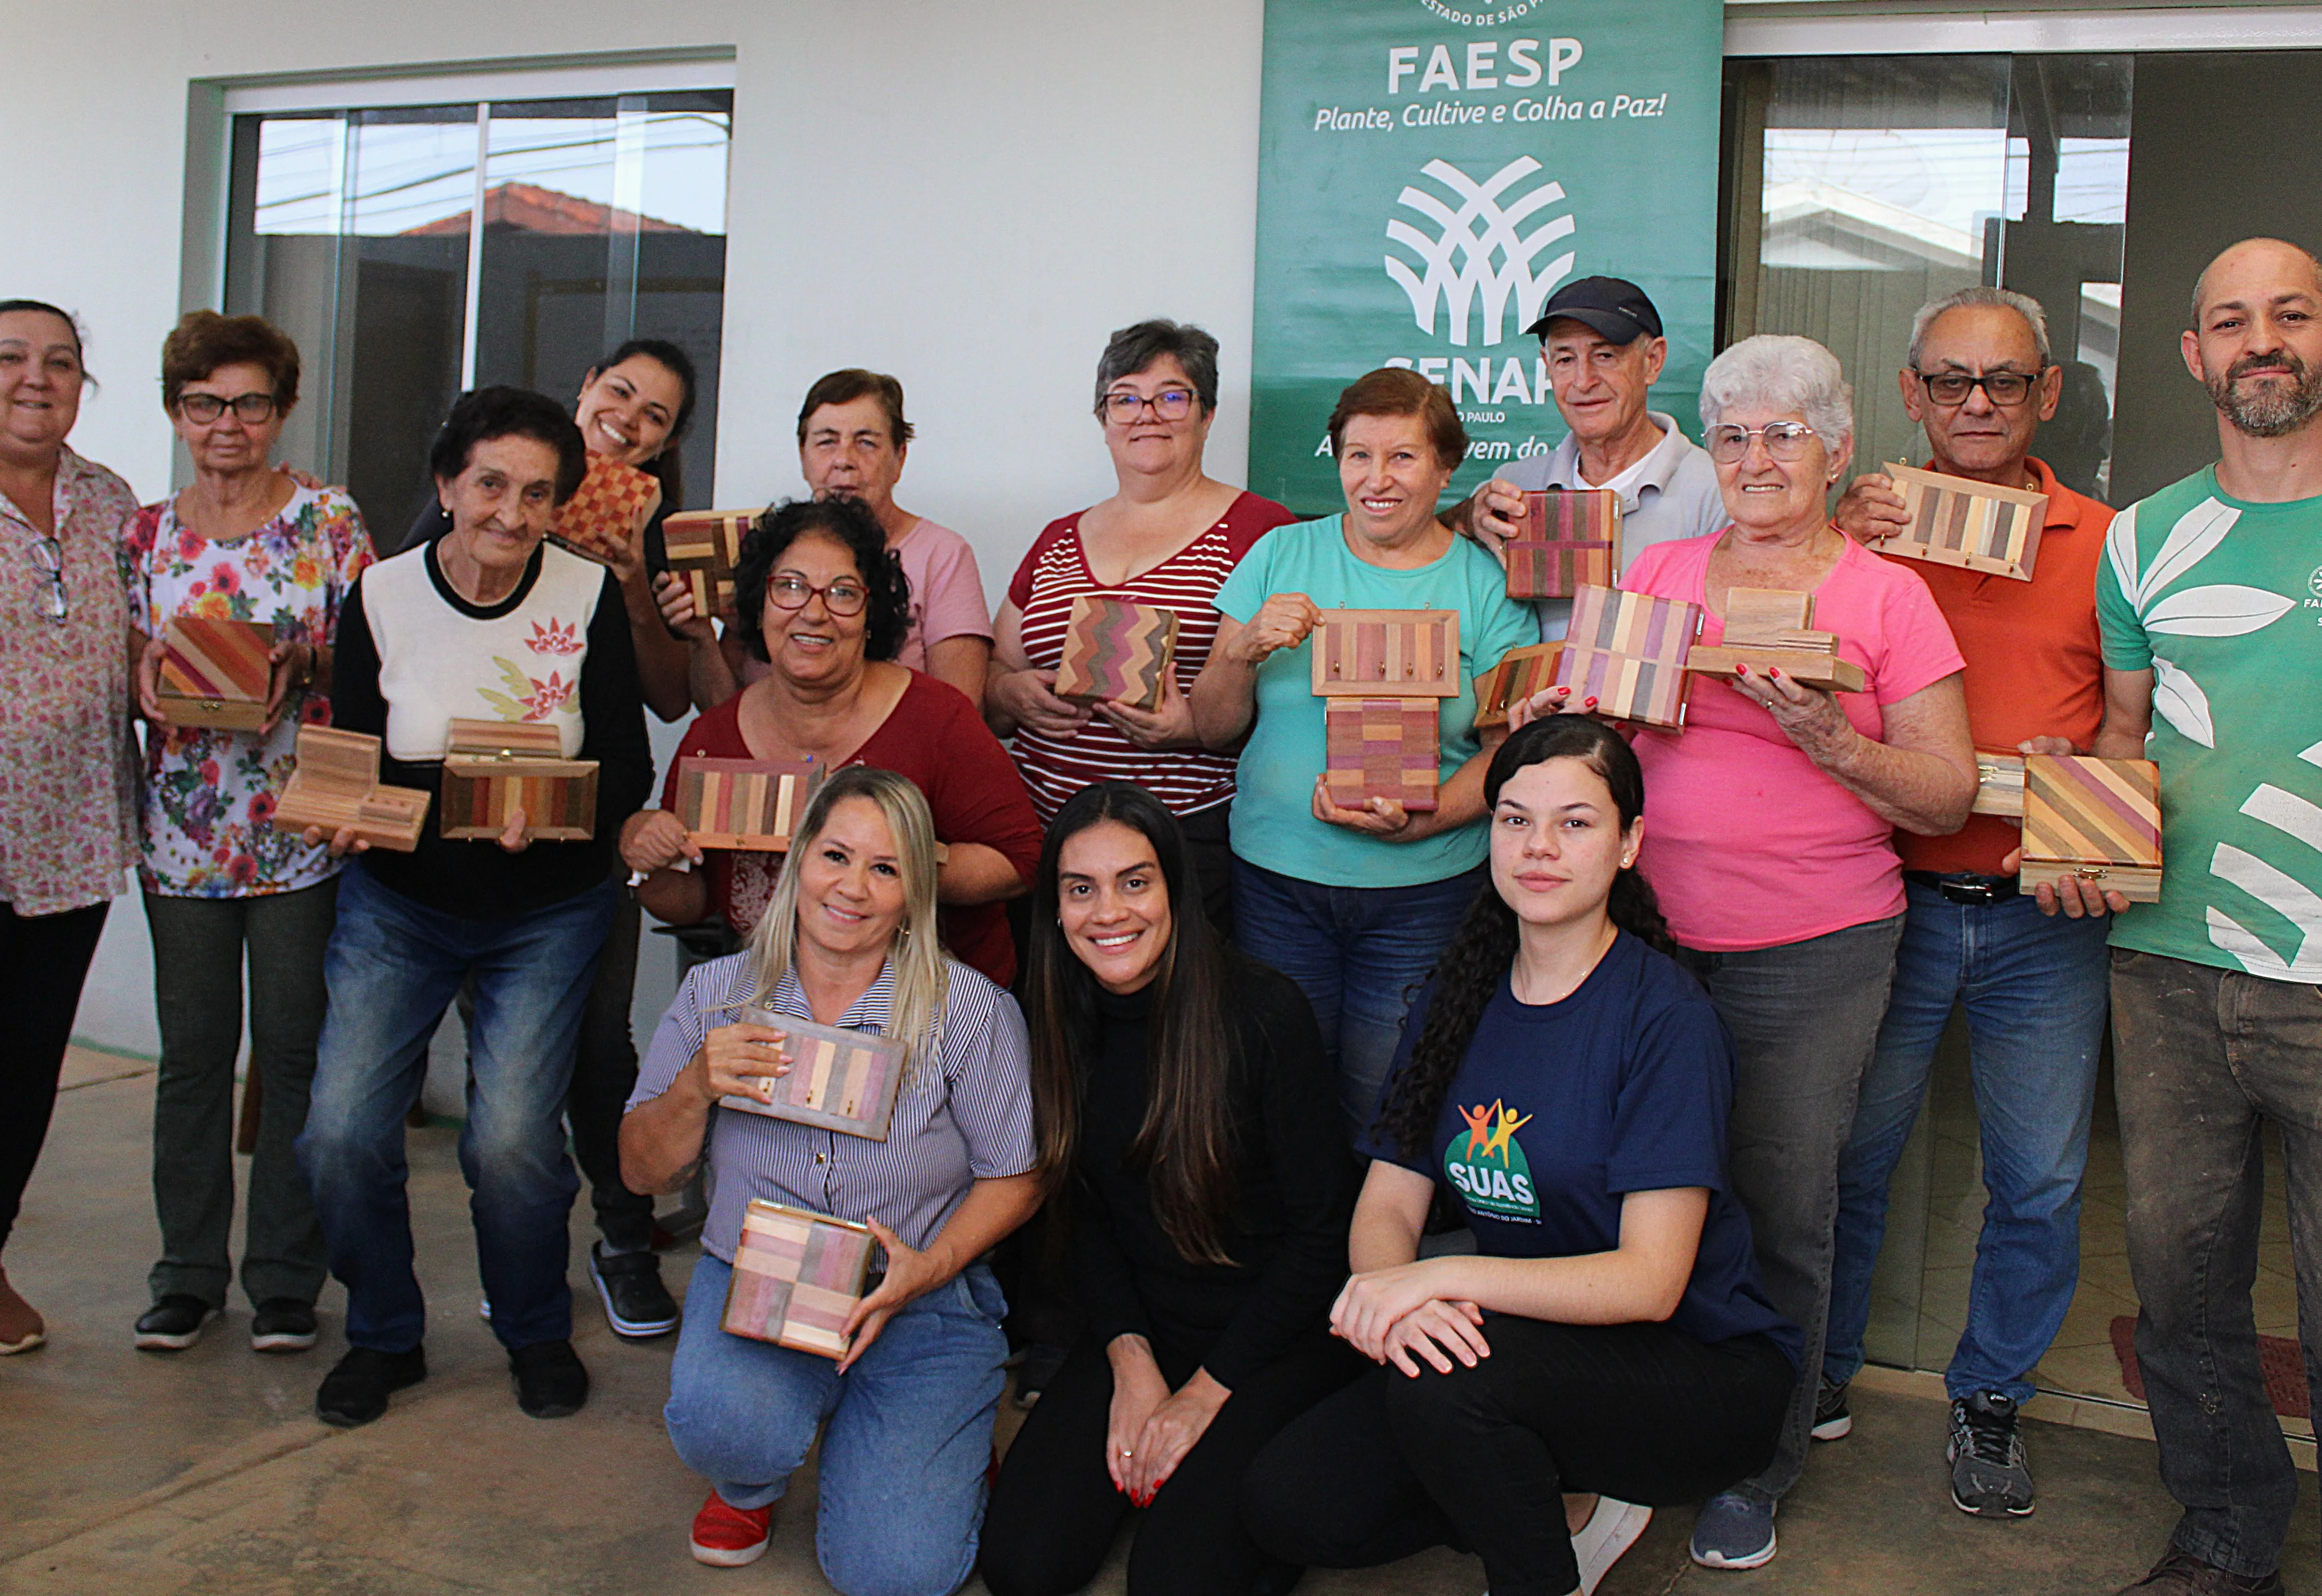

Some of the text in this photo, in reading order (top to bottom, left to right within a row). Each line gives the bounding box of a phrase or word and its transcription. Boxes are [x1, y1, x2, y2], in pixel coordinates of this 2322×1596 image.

[1476, 14, 1495, 26] DE
[1498, 4, 1527, 24] SÃO
[1388, 37, 1583, 94] FAESP
[1314, 93, 1667, 132] Plante, Cultive e Colha a Paz!
[1385, 357, 1554, 405] ENA
[1467, 411, 1505, 423] PAULO
[1517, 435, 1548, 460] do
[1449, 1162, 1534, 1205] SUAS
